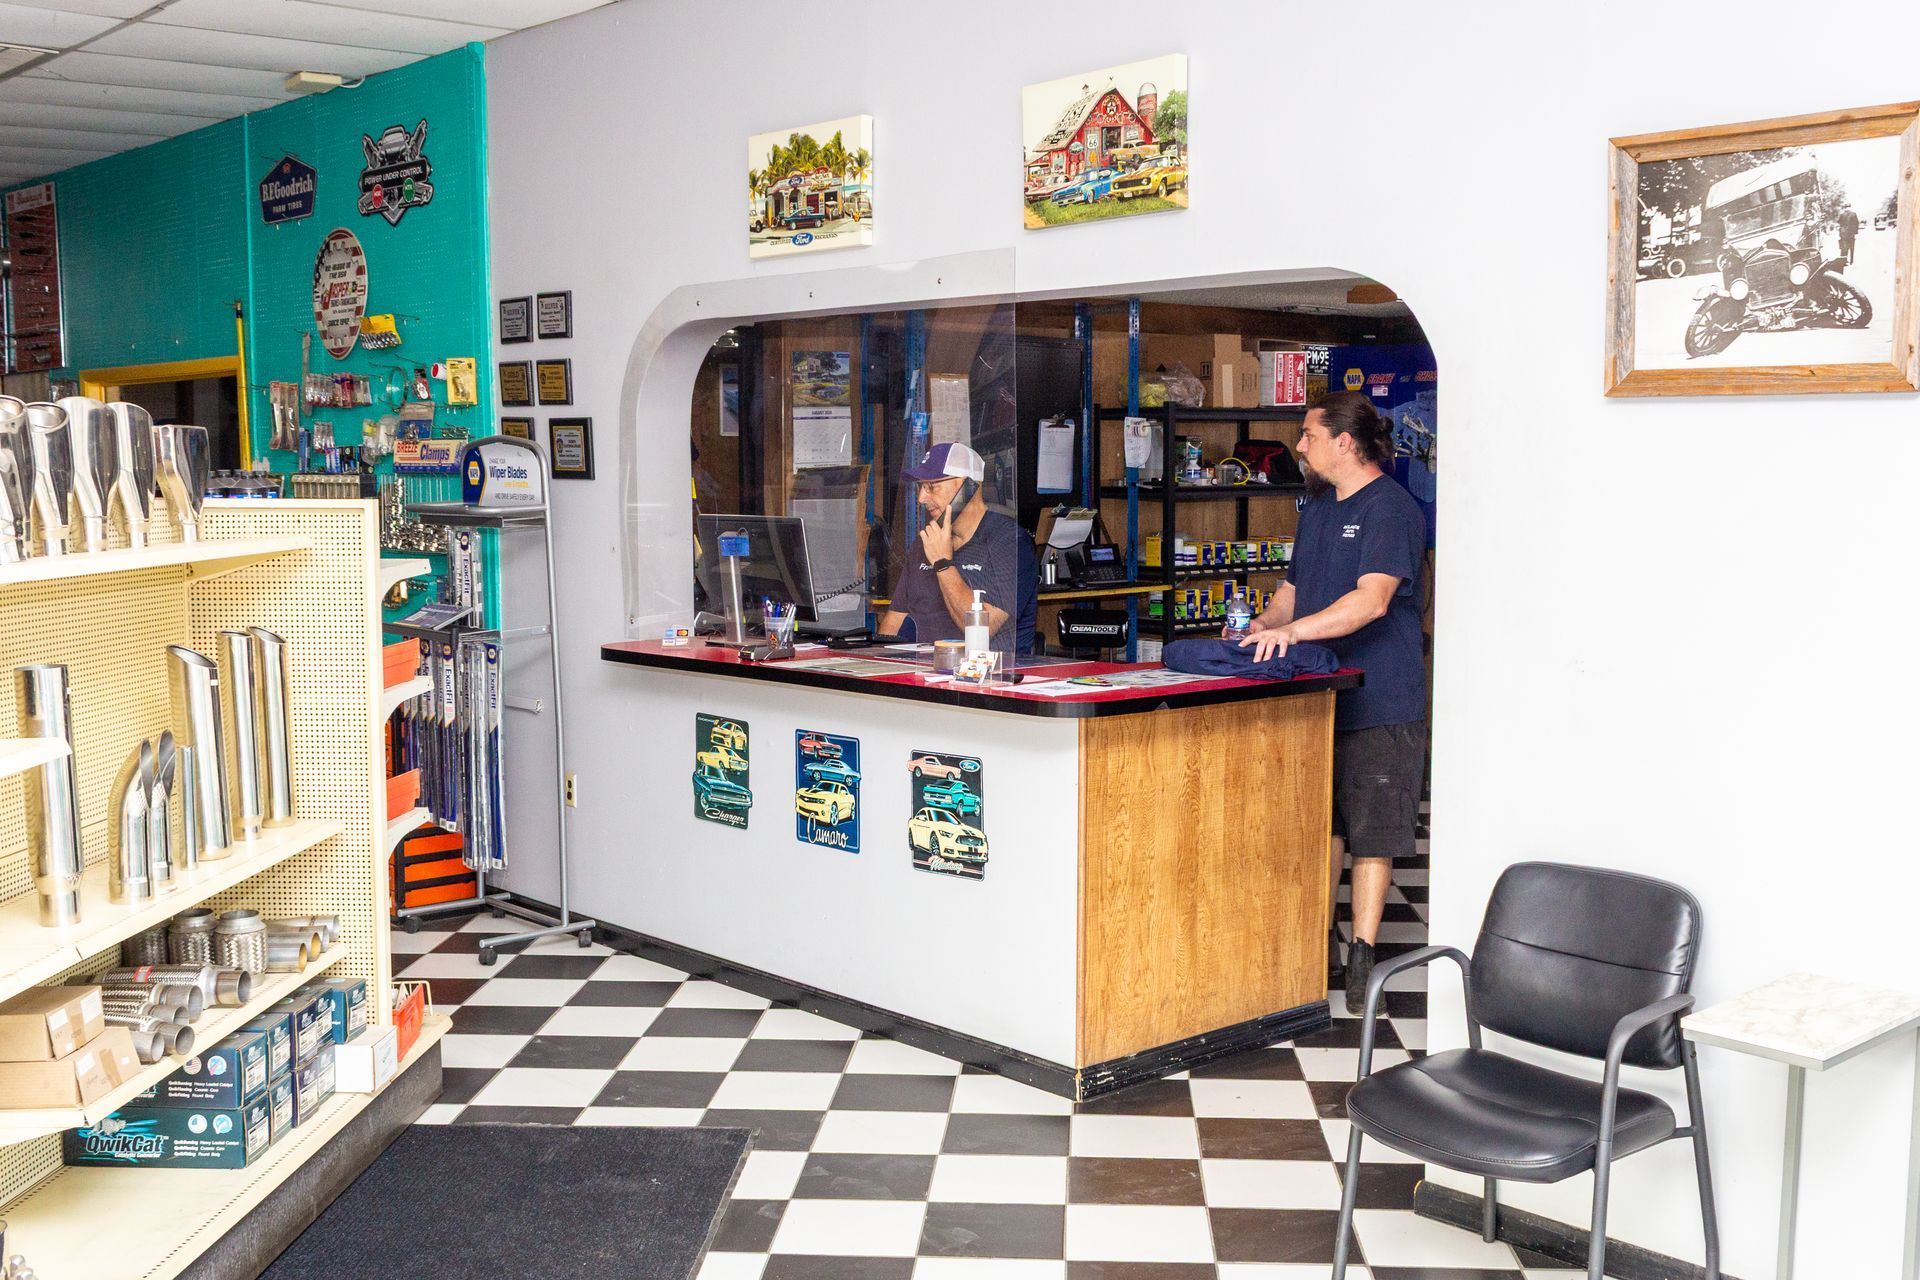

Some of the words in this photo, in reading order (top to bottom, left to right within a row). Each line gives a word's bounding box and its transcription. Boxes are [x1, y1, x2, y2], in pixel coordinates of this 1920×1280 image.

[1088, 139, 1098, 148] 66
[364, 175, 383, 185] POWER
[383, 171, 399, 181] UNDER
[400, 166, 423, 178] CONTROL
[794, 234, 811, 245] Ford
[1346, 375, 1362, 385] NAPA
[396, 441, 418, 453] BREEZE
[420, 444, 450, 466] Clamps
[470, 468, 479, 478] NAPA
[489, 466, 506, 480] Wiper
[507, 466, 528, 479] Blades
[445, 667, 453, 705] ExactFit
[490, 671, 498, 709] ExactFit
[961, 761, 977, 772] Ford
[704, 807, 747, 827] Charger
[806, 812, 849, 849] Camaro
